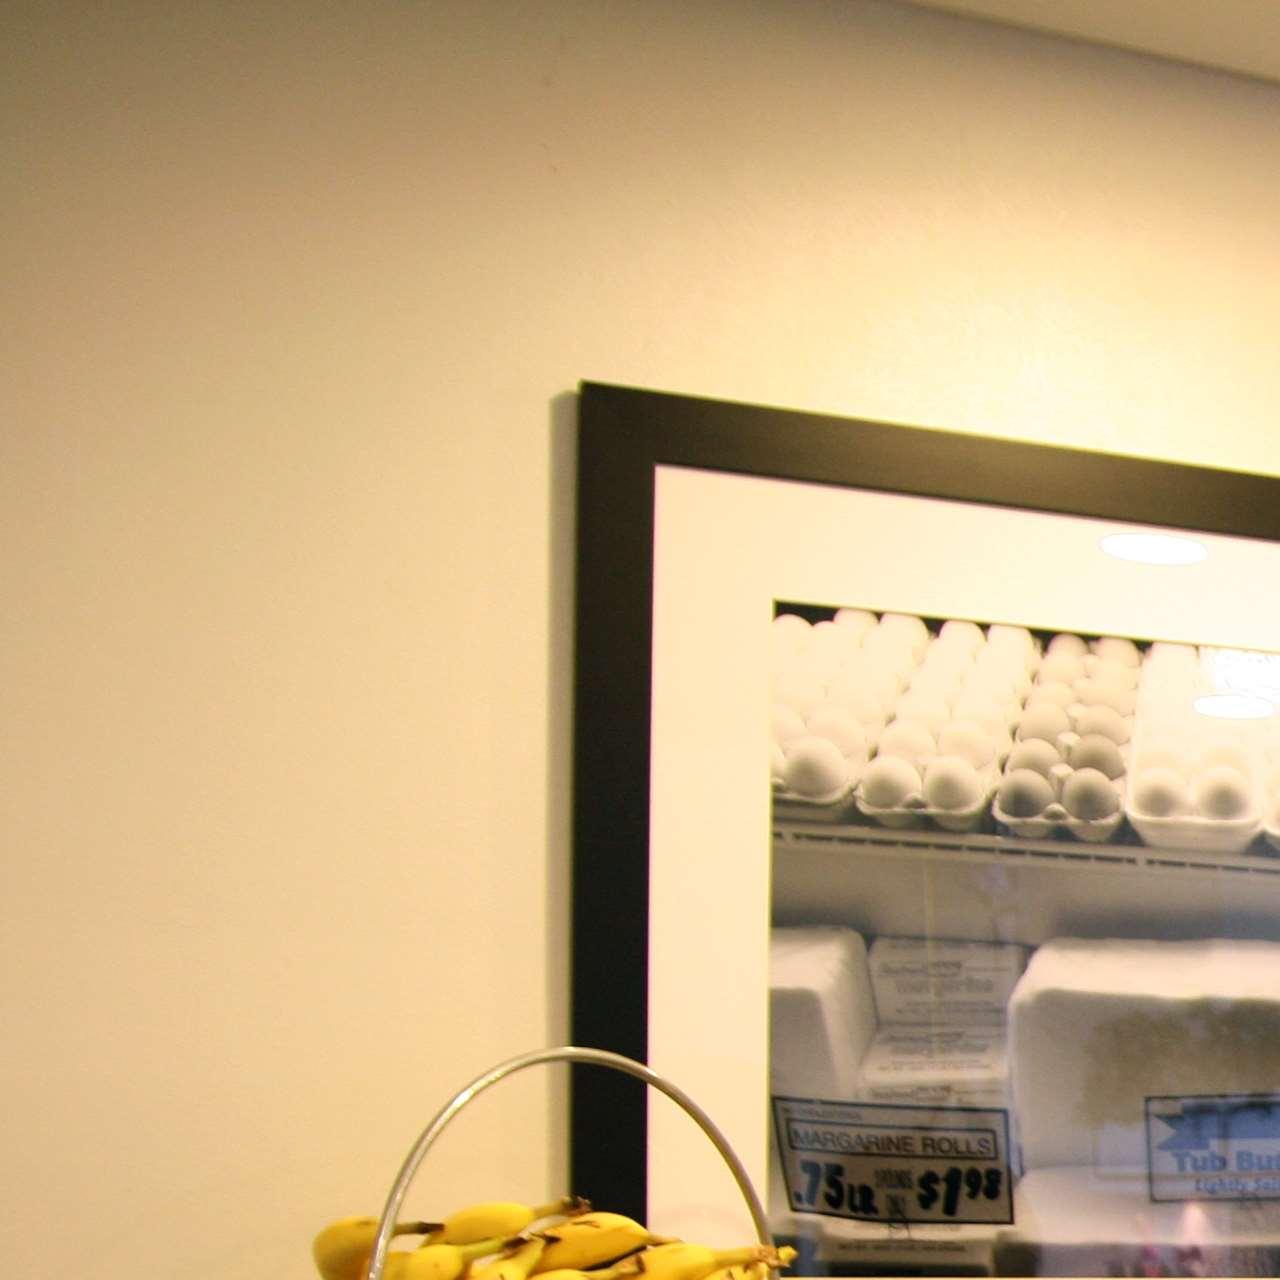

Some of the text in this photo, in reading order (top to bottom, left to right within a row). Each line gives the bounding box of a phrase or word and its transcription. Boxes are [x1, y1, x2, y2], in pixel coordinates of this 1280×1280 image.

[791, 1128, 992, 1155] MARGARINE ROLLS
[1173, 1151, 1228, 1172] Tub
